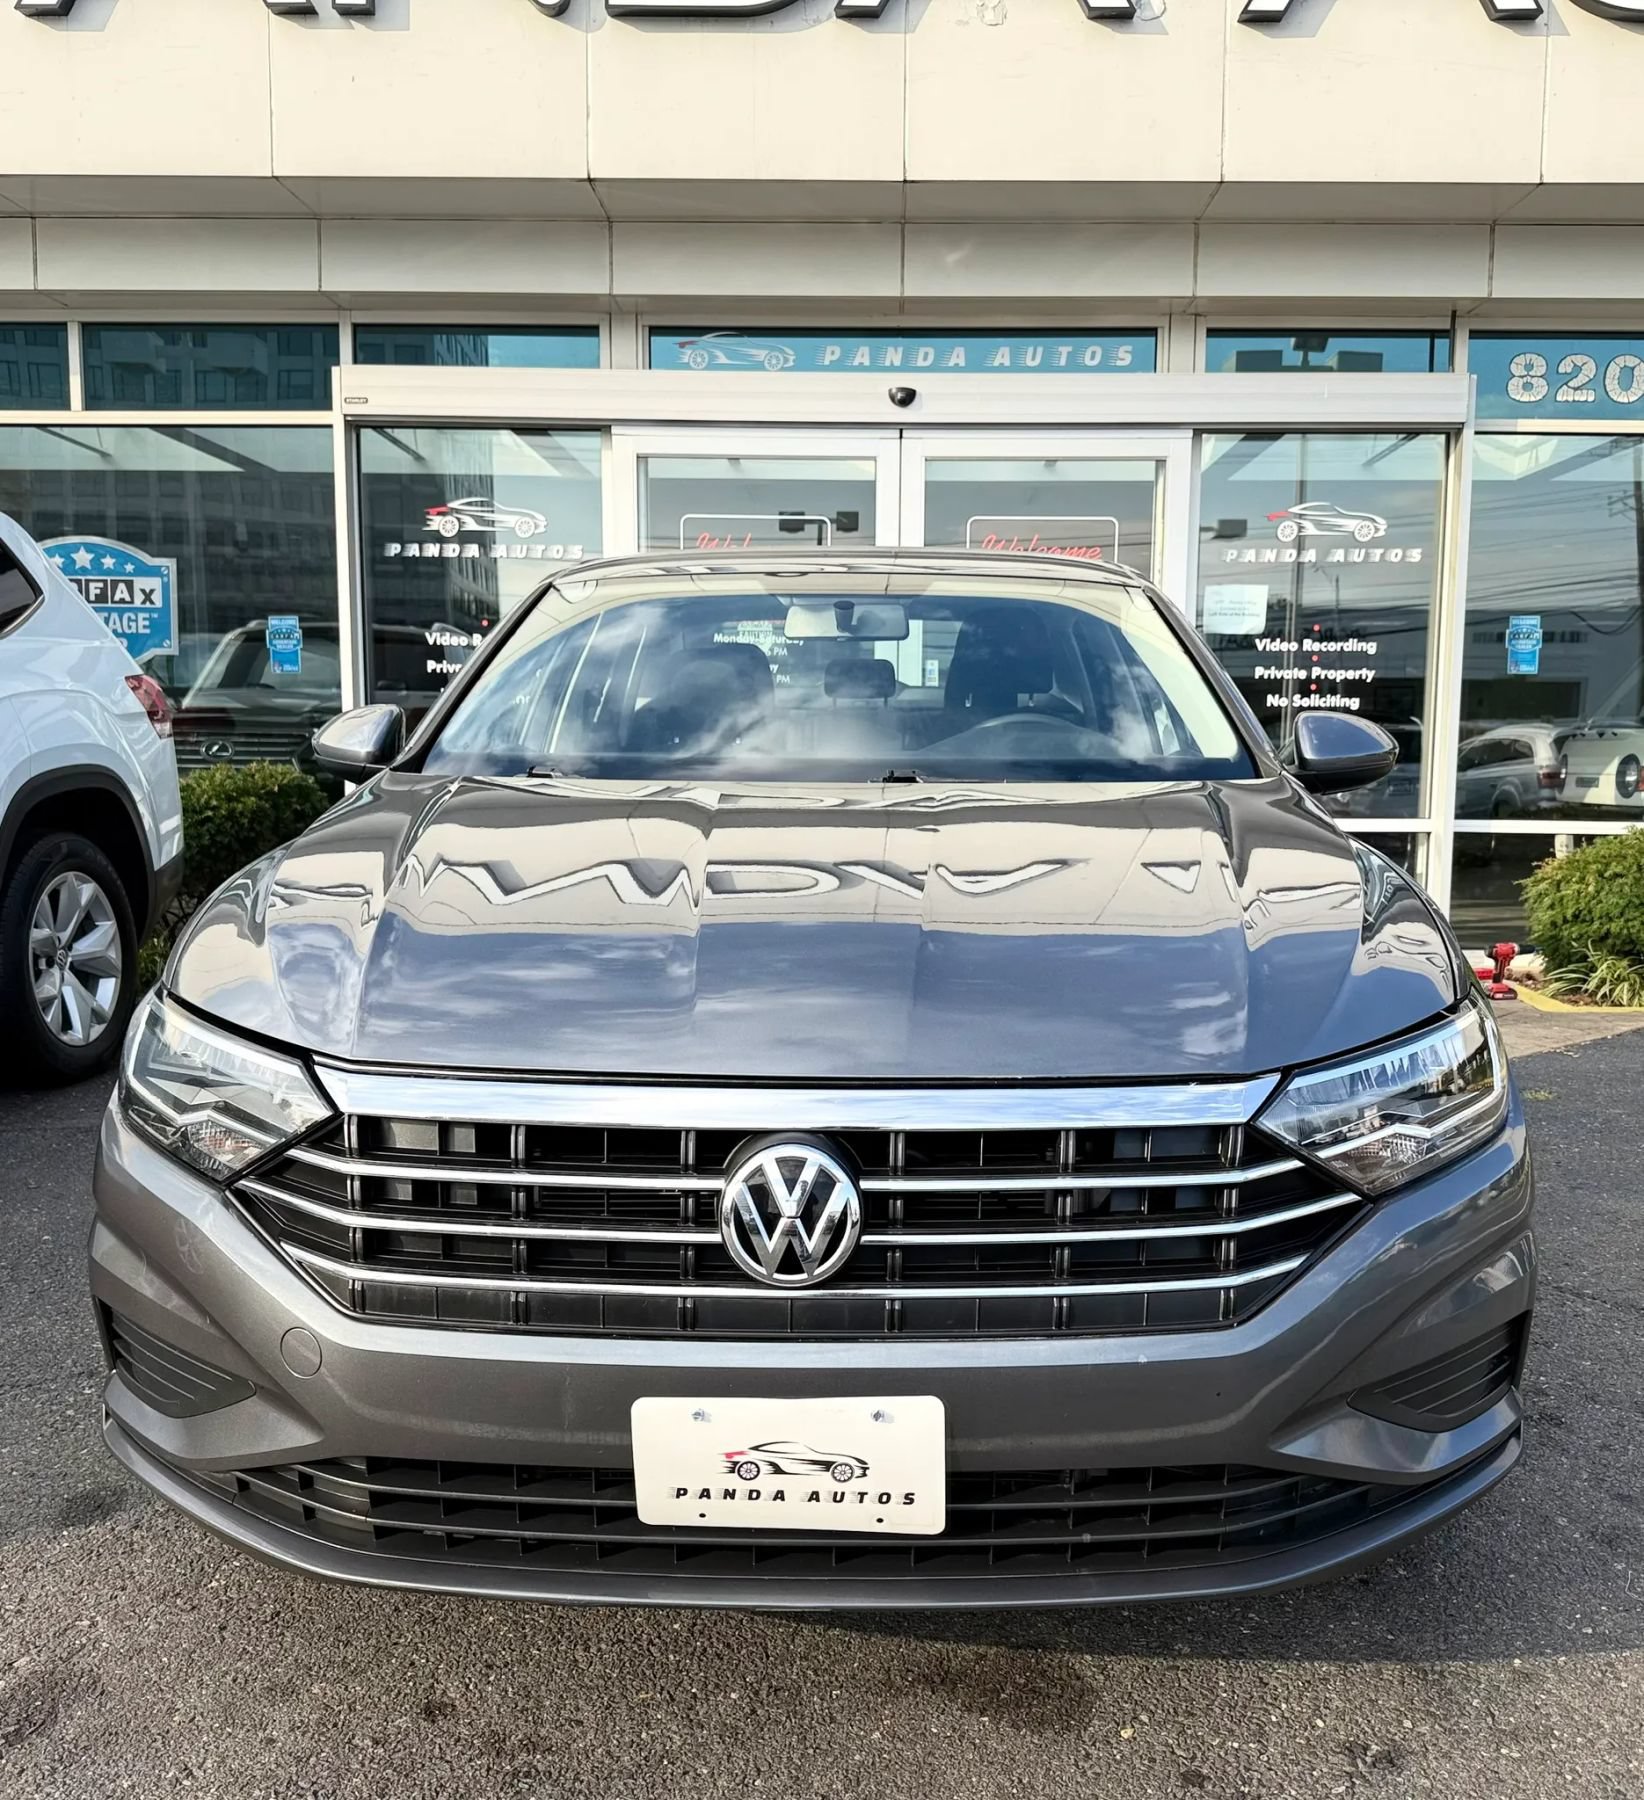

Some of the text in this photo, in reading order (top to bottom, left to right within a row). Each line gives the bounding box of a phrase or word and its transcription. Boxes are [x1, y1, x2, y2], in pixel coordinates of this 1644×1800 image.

[816, 345, 1133, 367] PANDA AUTOS
[1506, 352, 1644, 404] 820
[384, 543, 584, 560] PANDA AUTOS
[1223, 548, 1423, 563] PANDA AUTOS
[424, 632, 469, 647] Video
[1254, 638, 1299, 652] Video
[1302, 638, 1378, 655] Recording
[773, 647, 788, 656] PM
[776, 675, 791, 684] PM
[1254, 666, 1376, 683] Private Property
[1266, 693, 1361, 711] No Soliciting
[671, 1486, 916, 1506] PANDA AUTOS
